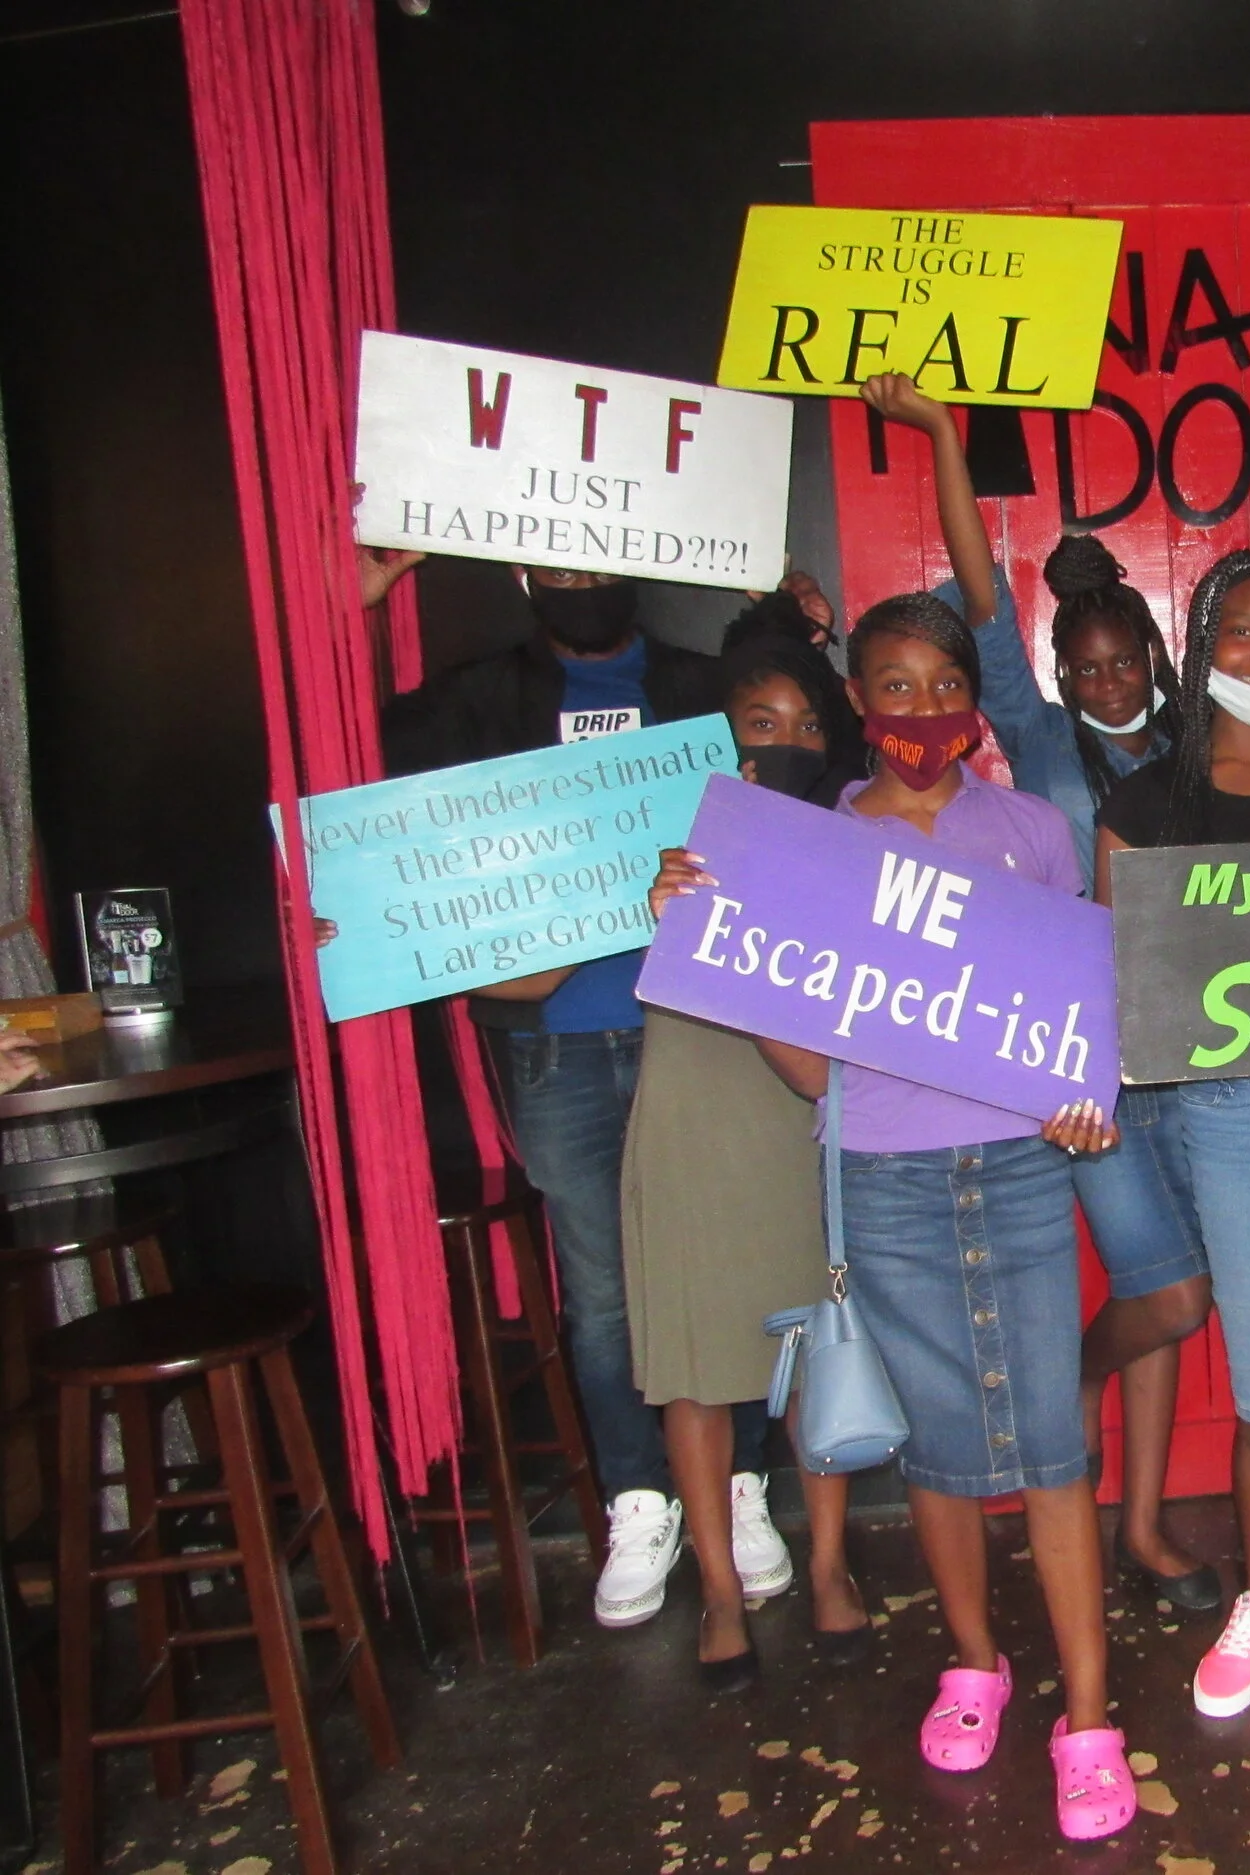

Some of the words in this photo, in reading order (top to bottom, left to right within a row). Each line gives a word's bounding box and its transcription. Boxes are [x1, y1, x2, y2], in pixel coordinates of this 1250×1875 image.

[818, 244, 1025, 279] STRUGGLE
[891, 216, 964, 245] THE
[900, 278, 932, 305] IS
[758, 305, 1049, 397] REAL
[521, 467, 641, 512] JUST
[399, 500, 749, 574] HAPPENED?!?!
[573, 712, 631, 733] DRIP
[425, 738, 724, 829] Underestimate
[392, 841, 462, 885] the
[470, 812, 602, 869] Power
[614, 796, 654, 835] of
[384, 881, 519, 939] Stupid
[522, 849, 650, 906] People
[872, 851, 972, 950] WE
[414, 923, 539, 982] Large
[692, 894, 1092, 1084] Escaped-ish
